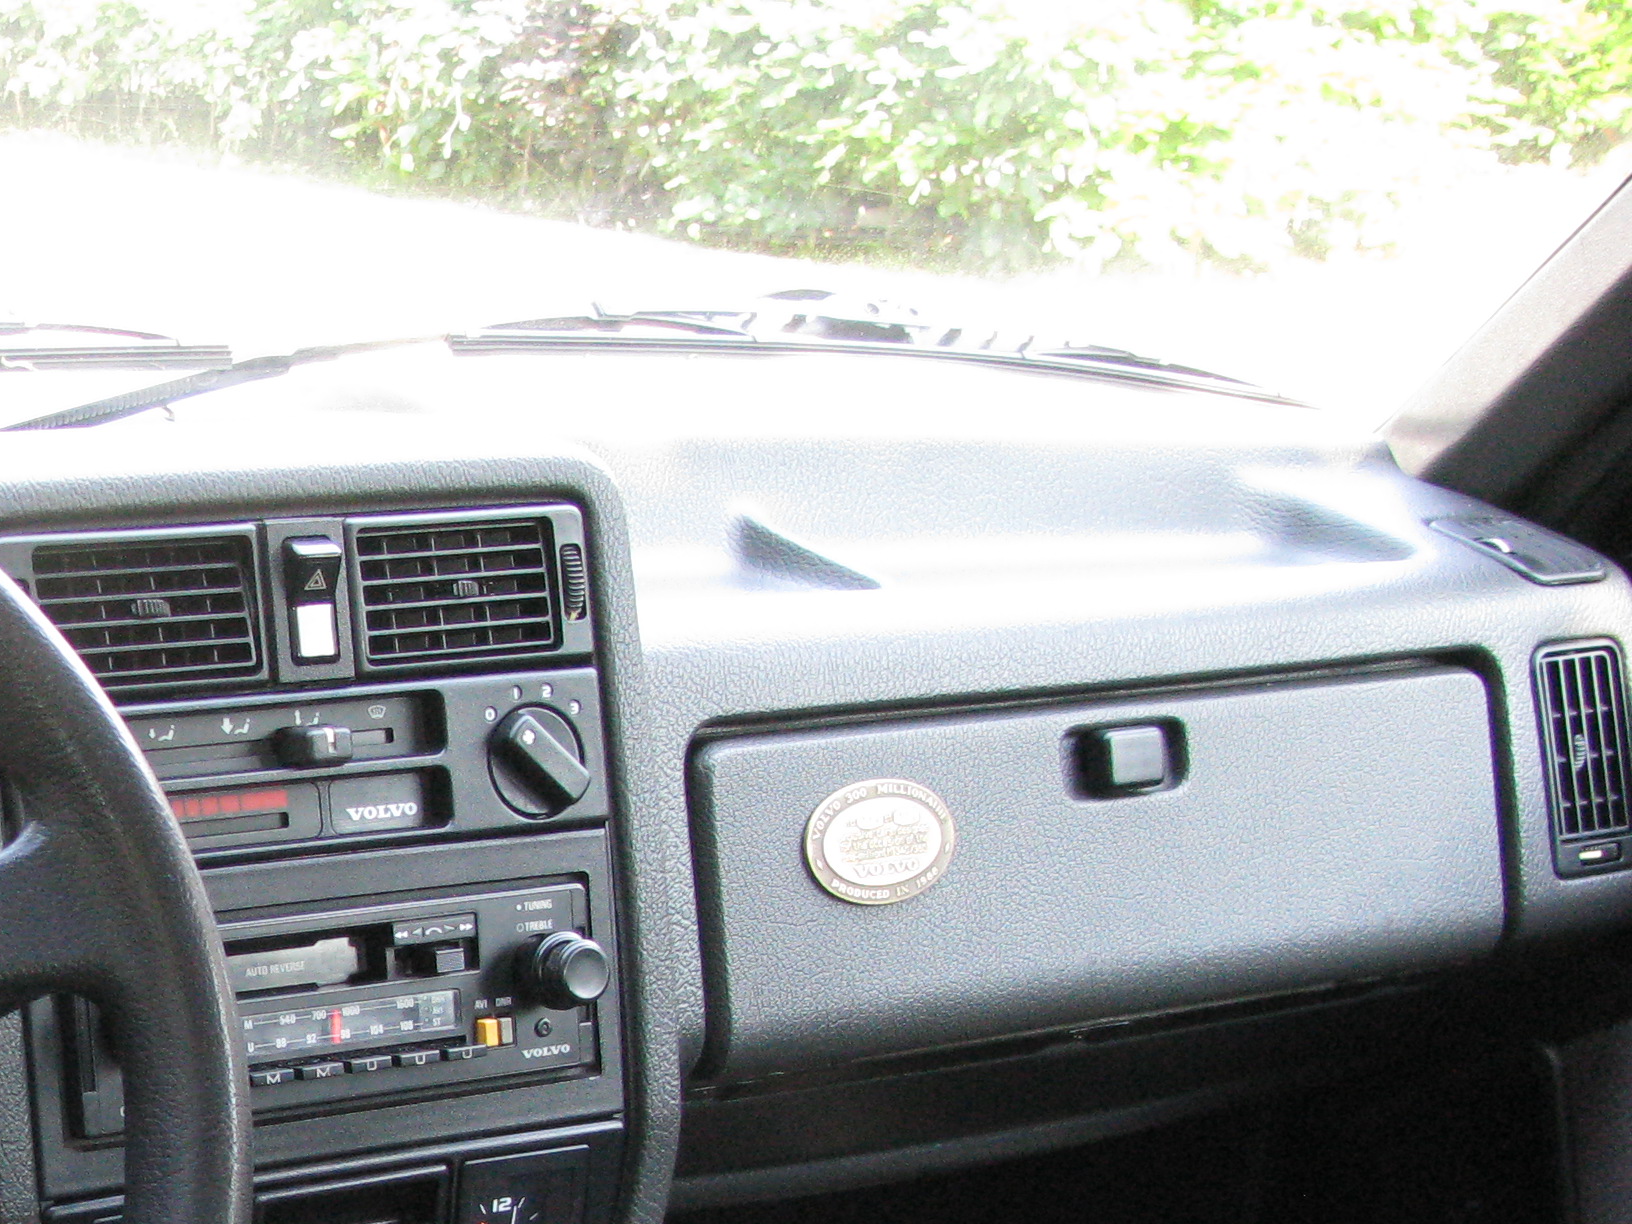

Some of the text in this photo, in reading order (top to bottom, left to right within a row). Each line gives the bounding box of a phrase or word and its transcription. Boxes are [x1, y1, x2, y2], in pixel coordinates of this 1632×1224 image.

[511, 686, 519, 700] 1
[540, 684, 552, 698] 2
[484, 707, 496, 721] 0
[569, 700, 580, 715] 3
[346, 802, 418, 821] VOLVO
[812, 800, 841, 840] VOLVO
[845, 787, 867, 804] 300
[853, 857, 920, 879] VOLVO
[830, 878, 891, 900] PRODUCED
[895, 884, 910, 897] IN
[523, 899, 553, 911] TUNING
[524, 919, 553, 932] TREBLE
[245, 960, 305, 978] AUTO REVERSE
[244, 1020, 254, 1030] M
[279, 1014, 296, 1025] 540
[311, 1010, 327, 1020] 700
[247, 1042, 254, 1053] U
[306, 1033, 317, 1044] 92
[370, 1024, 384, 1035] 104
[520, 1043, 571, 1059] VOLVO
[266, 1071, 281, 1085] M
[316, 1065, 330, 1078] M
[492, 1196, 513, 1213] 12
